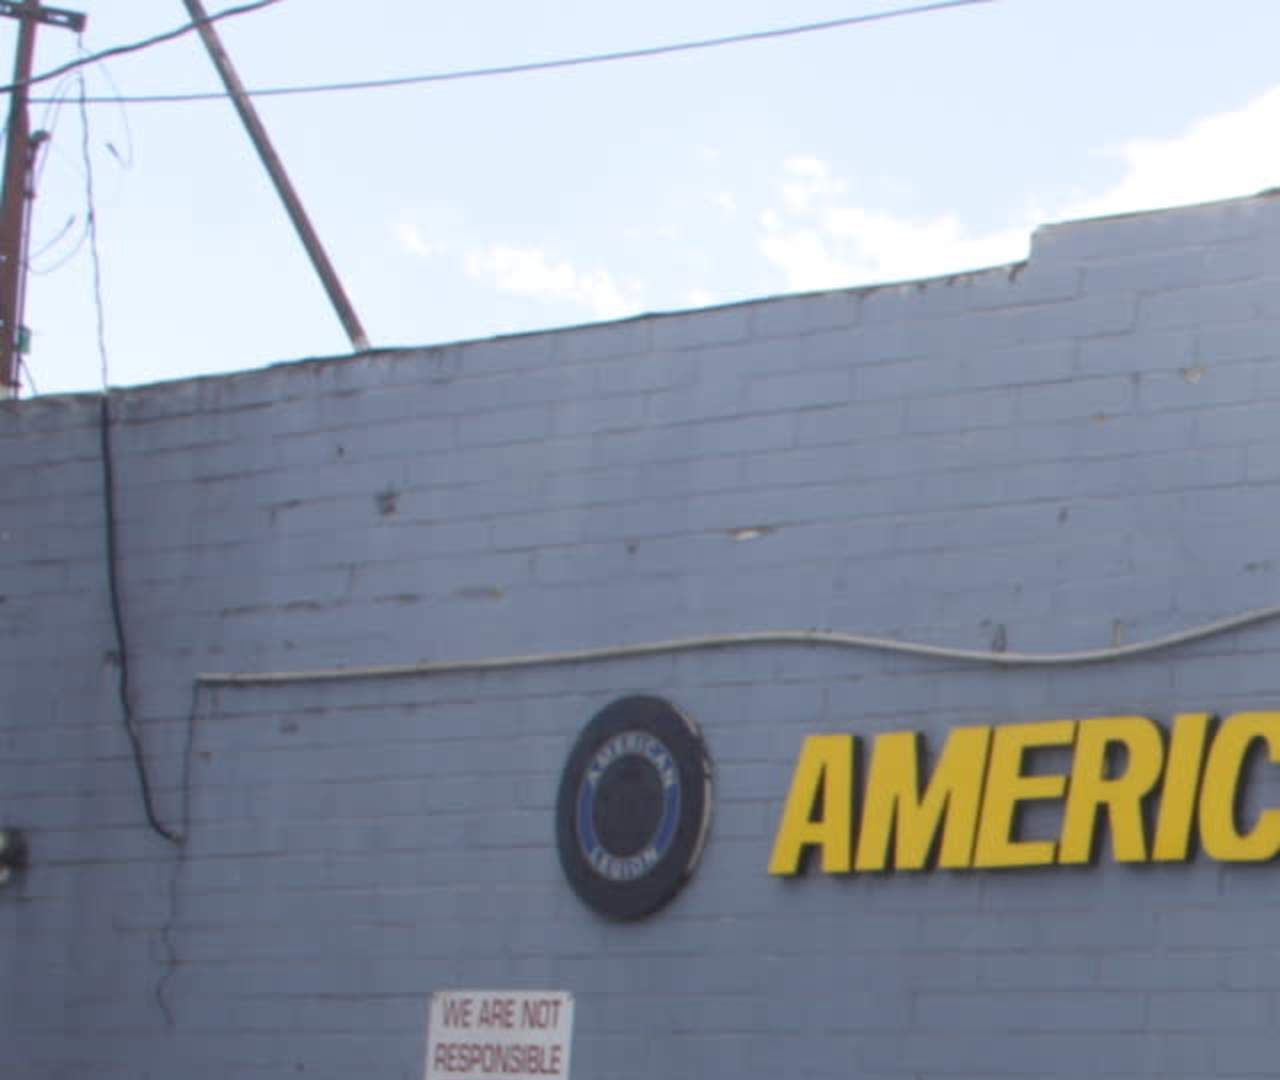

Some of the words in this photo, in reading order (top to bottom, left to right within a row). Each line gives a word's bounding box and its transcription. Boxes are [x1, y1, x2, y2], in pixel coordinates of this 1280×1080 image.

[443, 999, 472, 1029] WE
[478, 999, 514, 1029] ARE
[521, 1000, 563, 1029] NOT
[434, 1043, 561, 1074] RESPONSIBLE
